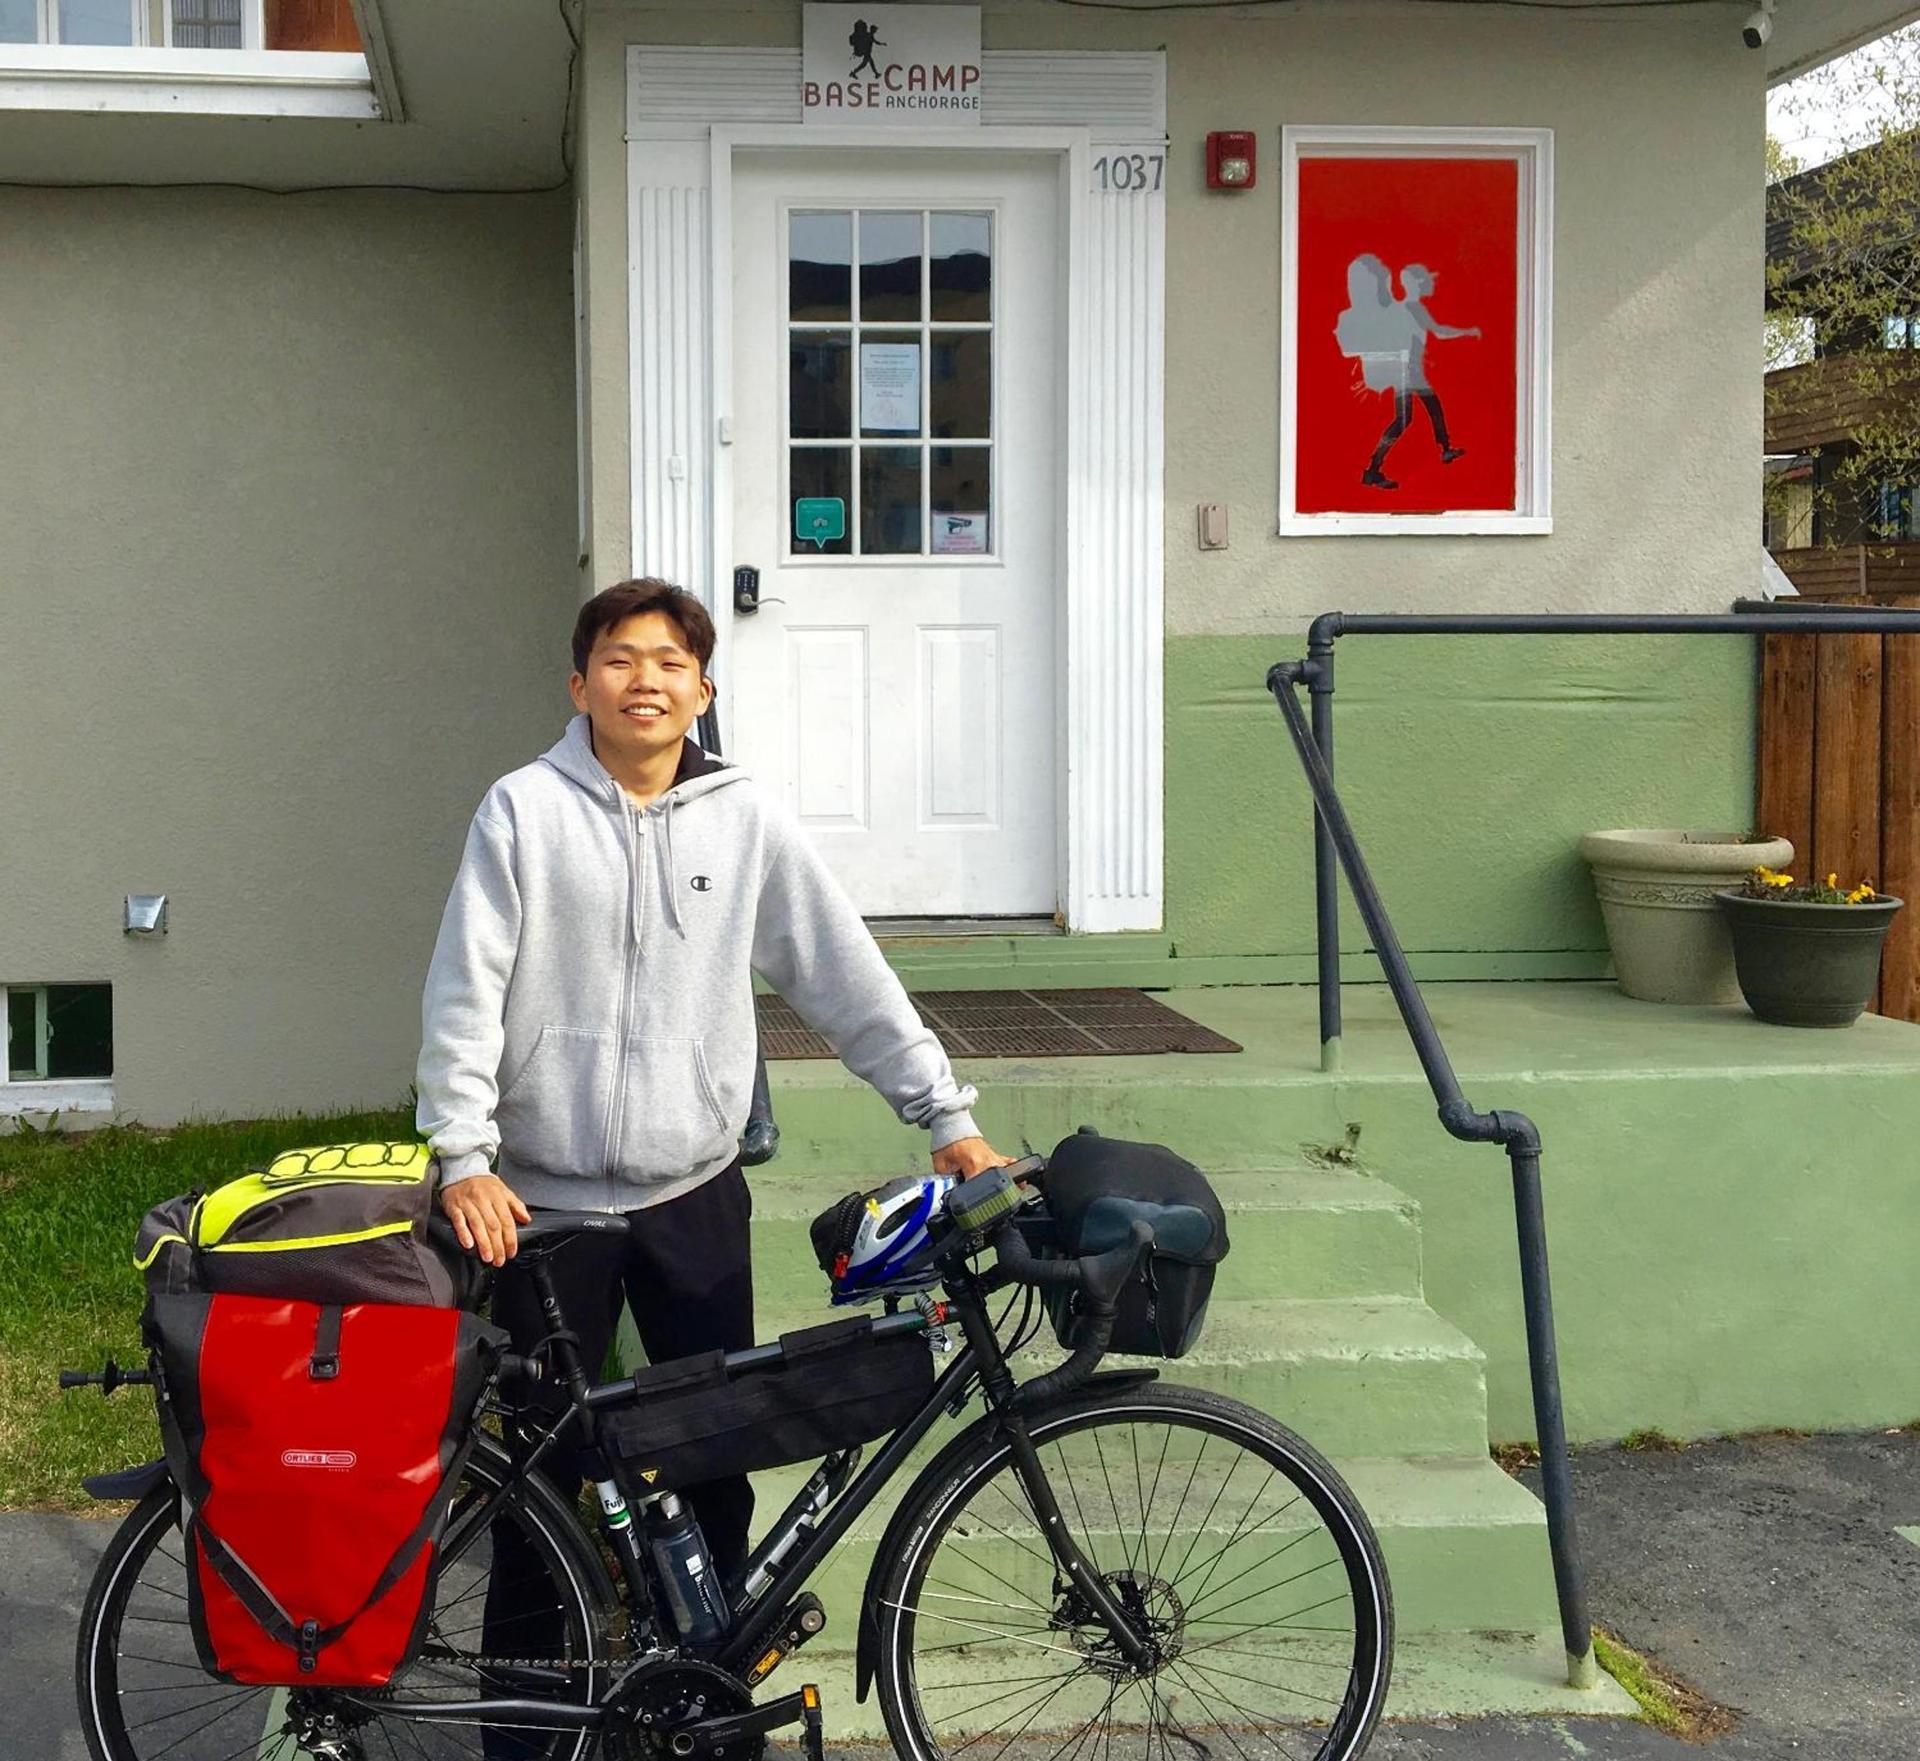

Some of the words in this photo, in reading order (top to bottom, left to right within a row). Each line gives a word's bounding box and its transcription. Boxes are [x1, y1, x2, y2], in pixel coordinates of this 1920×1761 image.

[804, 82, 880, 108] BASE
[883, 63, 981, 92] CAMP
[885, 95, 979, 110] ANCHORAGE
[1093, 153, 1164, 191] 1037
[604, 1496, 624, 1510] Fuji
